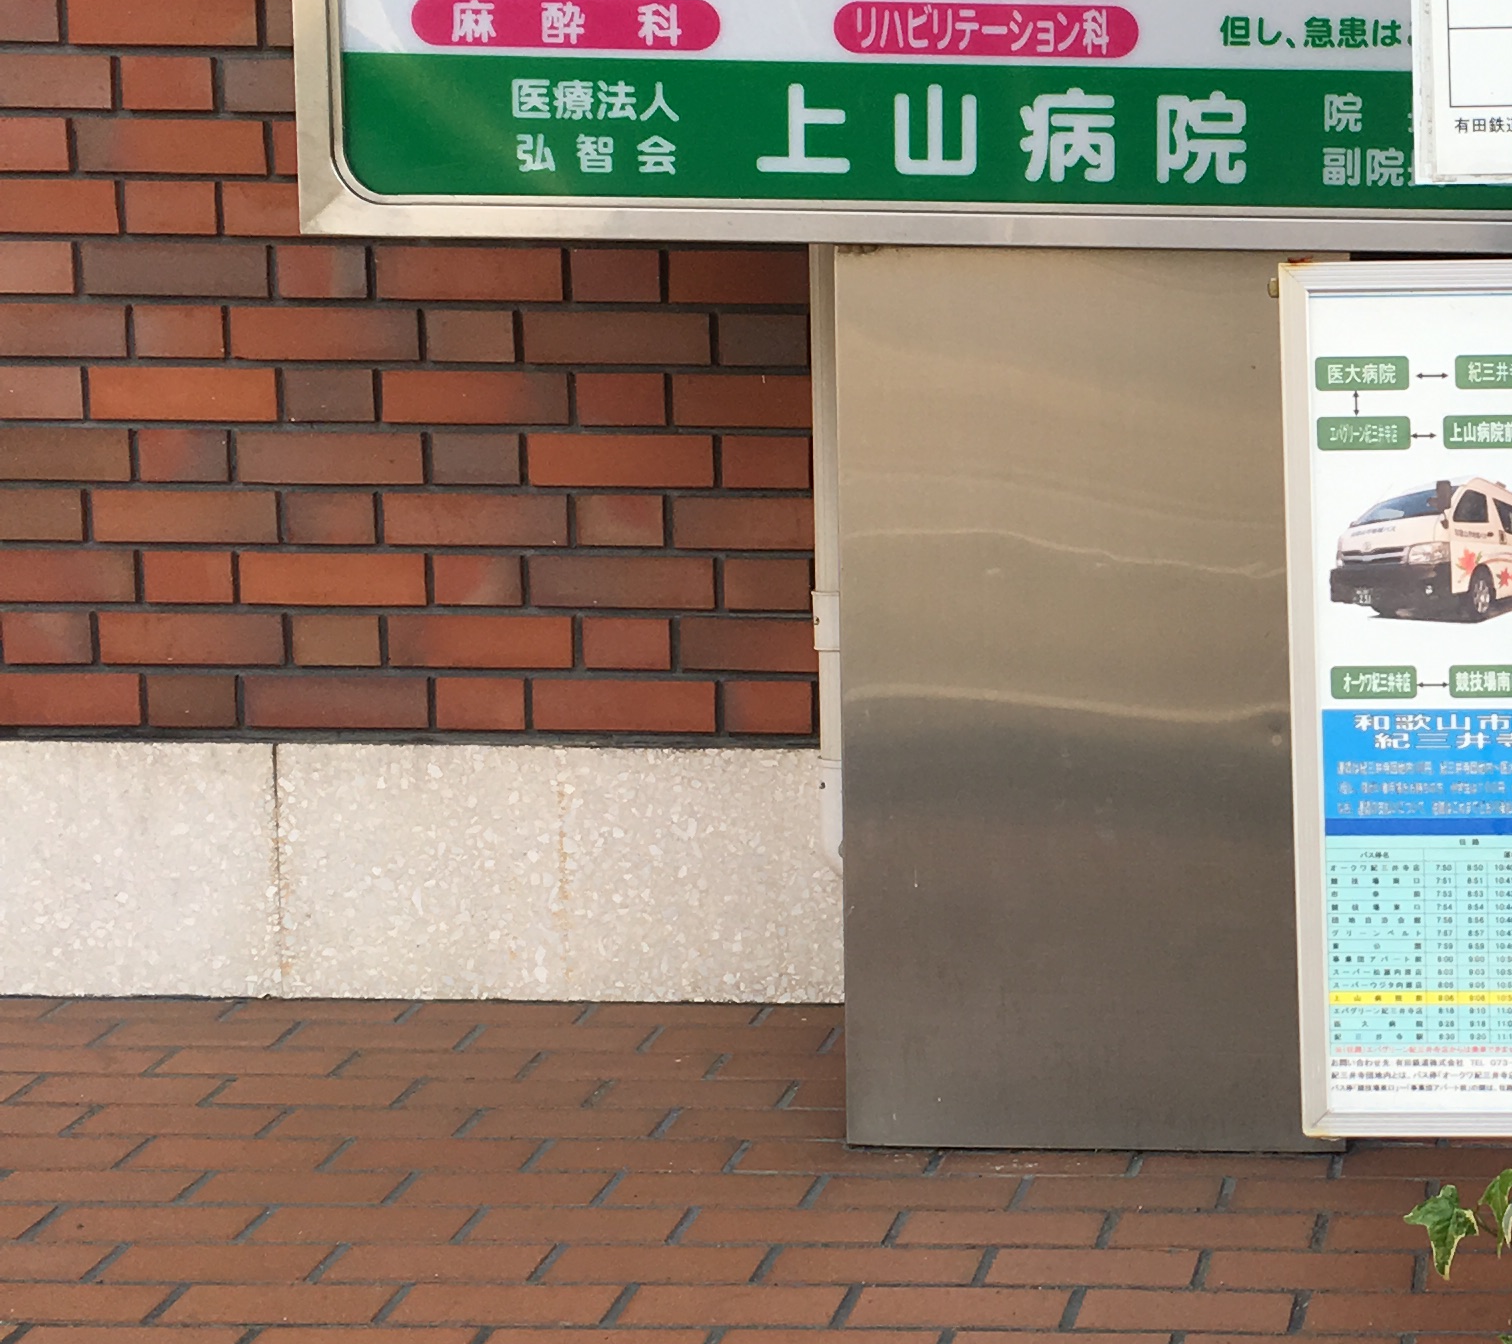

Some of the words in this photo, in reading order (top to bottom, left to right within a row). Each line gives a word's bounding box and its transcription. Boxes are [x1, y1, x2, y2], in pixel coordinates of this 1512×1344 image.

[855, 4, 1110, 55] リハビリテーション科
[1219, 15, 1413, 49] 但し、急患は
[511, 78, 680, 122] 医療法人
[516, 133, 677, 175] 弘智会
[756, 83, 1247, 184] 上山病院
[1327, 363, 1397, 386] 医大病院
